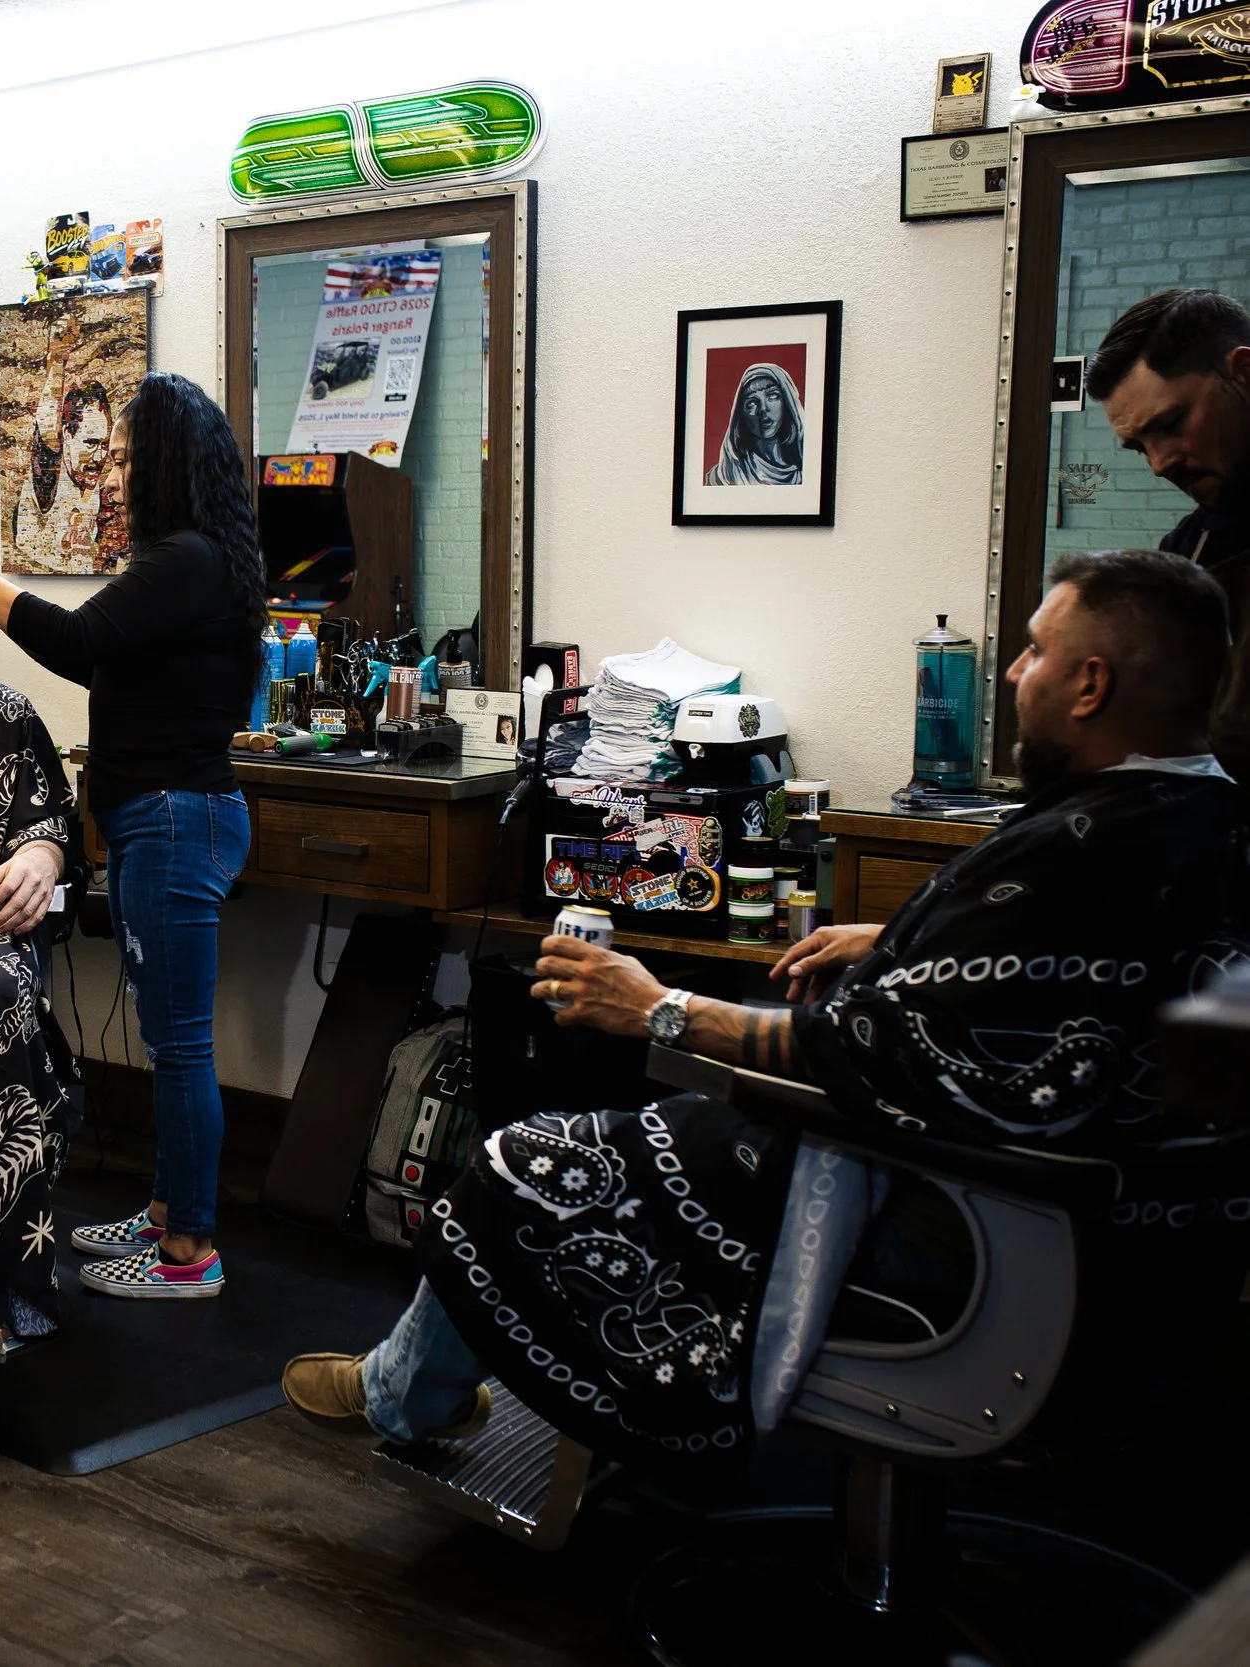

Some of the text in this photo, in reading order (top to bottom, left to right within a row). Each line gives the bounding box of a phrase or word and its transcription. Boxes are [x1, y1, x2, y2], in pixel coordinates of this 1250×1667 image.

[928, 163, 959, 171] BARBERING
[556, 840, 598, 857] TIME
[584, 862, 618, 873] SEDICI
[631, 876, 673, 897] STONE
